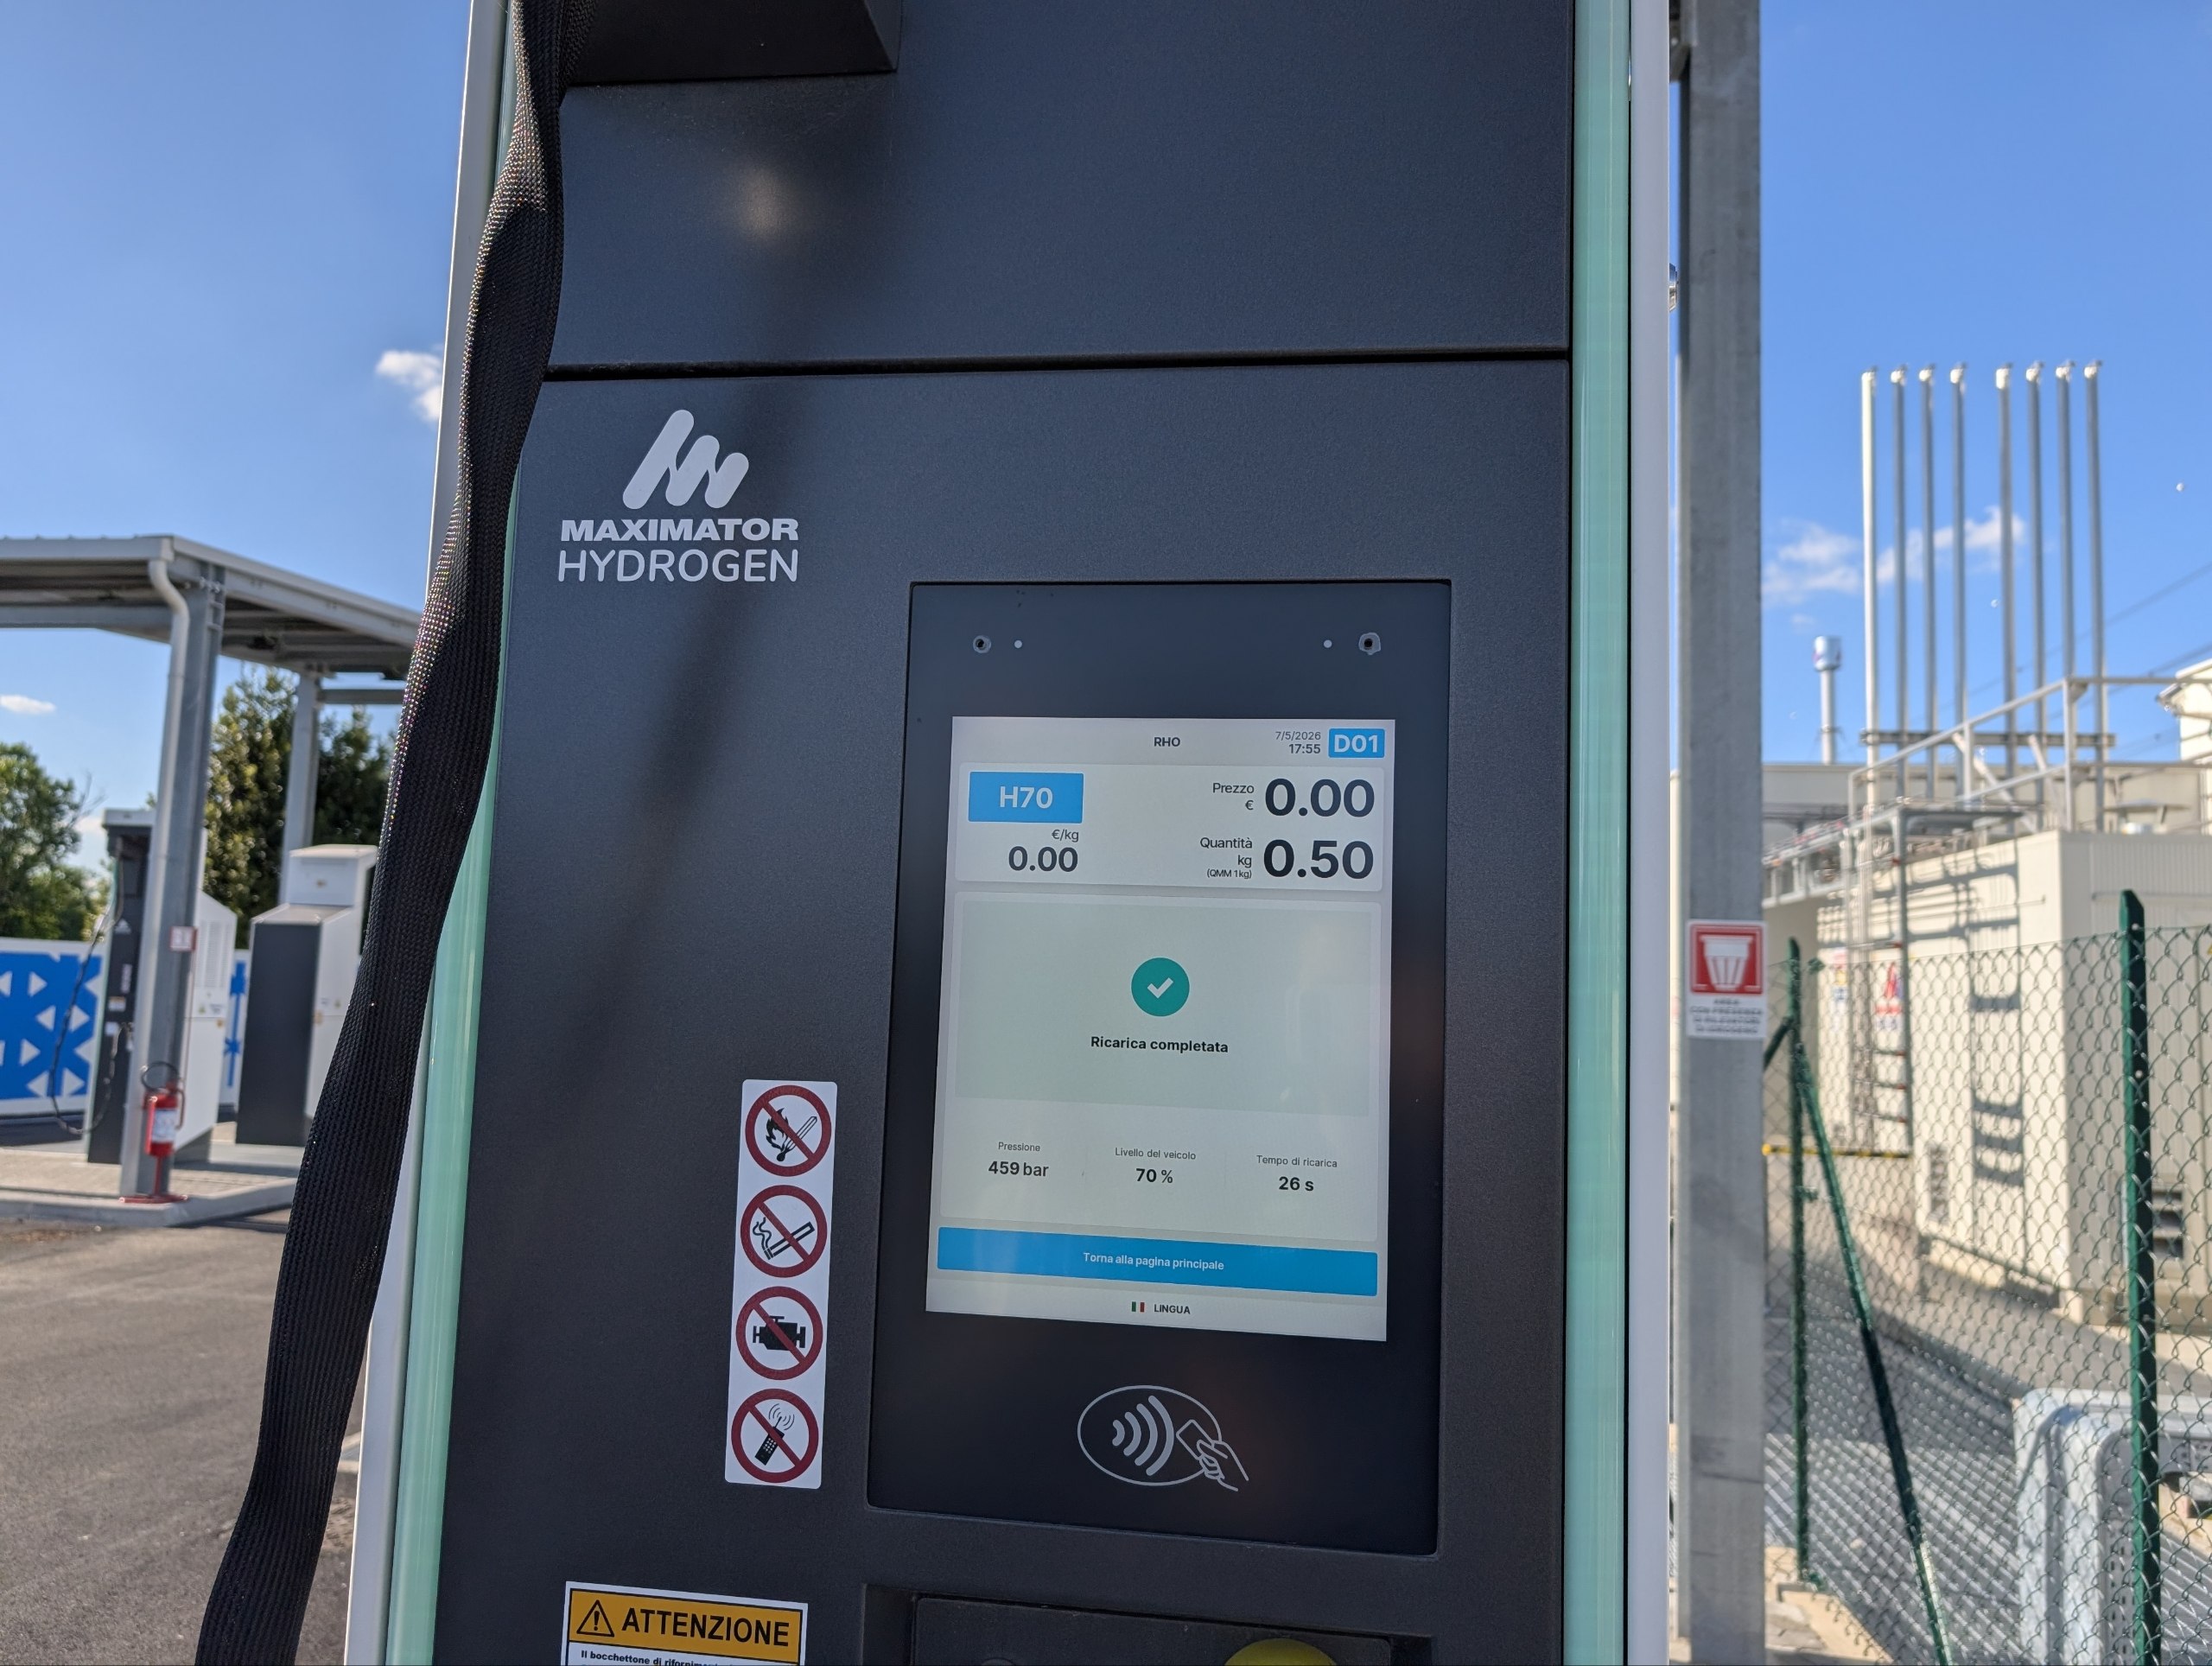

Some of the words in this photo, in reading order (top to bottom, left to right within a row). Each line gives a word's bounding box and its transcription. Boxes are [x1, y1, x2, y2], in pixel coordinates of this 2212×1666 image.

[561, 518, 798, 541] MAXIMATOR
[558, 550, 798, 582] HYDROGEN
[1154, 736, 1181, 747] RHO
[1274, 730, 1321, 741] 7/5/2026
[1288, 743, 1321, 754] 17:55
[1333, 734, 1378, 754] D01
[1212, 782, 1255, 794] Prezzo
[1001, 786, 1052, 808] H70
[1244, 799, 1254, 811] €
[1266, 779, 1374, 817] 0.00
[1051, 828, 1079, 843] €/kg
[1199, 836, 1253, 849] Quantità
[1009, 846, 1077, 872] 0.00
[1237, 854, 1252, 868] kg
[1264, 840, 1373, 879] 0.50
[1206, 868, 1232, 878] (QMM
[1233, 868, 1252, 880] 1kg)
[1090, 1035, 1147, 1050] Ricarica
[1149, 1040, 1229, 1054] completata
[998, 1141, 1041, 1152] Pressione
[1115, 1147, 1144, 1157] Livello
[1147, 1148, 1161, 1158] del
[1163, 1151, 1197, 1160] veicolo
[988, 1160, 1020, 1175] 459
[1023, 1161, 1049, 1177] bar
[1255, 1154, 1288, 1167] Tempo
[1291, 1157, 1300, 1166] di
[1303, 1157, 1338, 1168] ricarica
[1135, 1167, 1157, 1183] 70
[1160, 1169, 1173, 1184] %
[1278, 1176, 1300, 1191] 26
[1305, 1180, 1314, 1192] s
[1083, 1252, 1114, 1263] Torna
[1115, 1255, 1134, 1265] alla
[1135, 1256, 1171, 1269] pagina
[1172, 1259, 1224, 1272] principale
[1154, 1304, 1191, 1315] LINGUA
[622, 1608, 790, 1647] ATTENZIONE
[581, 1650, 588, 1659] Il
[589, 1650, 651, 1665] bocchettone
[652, 1657, 662, 1666] di
